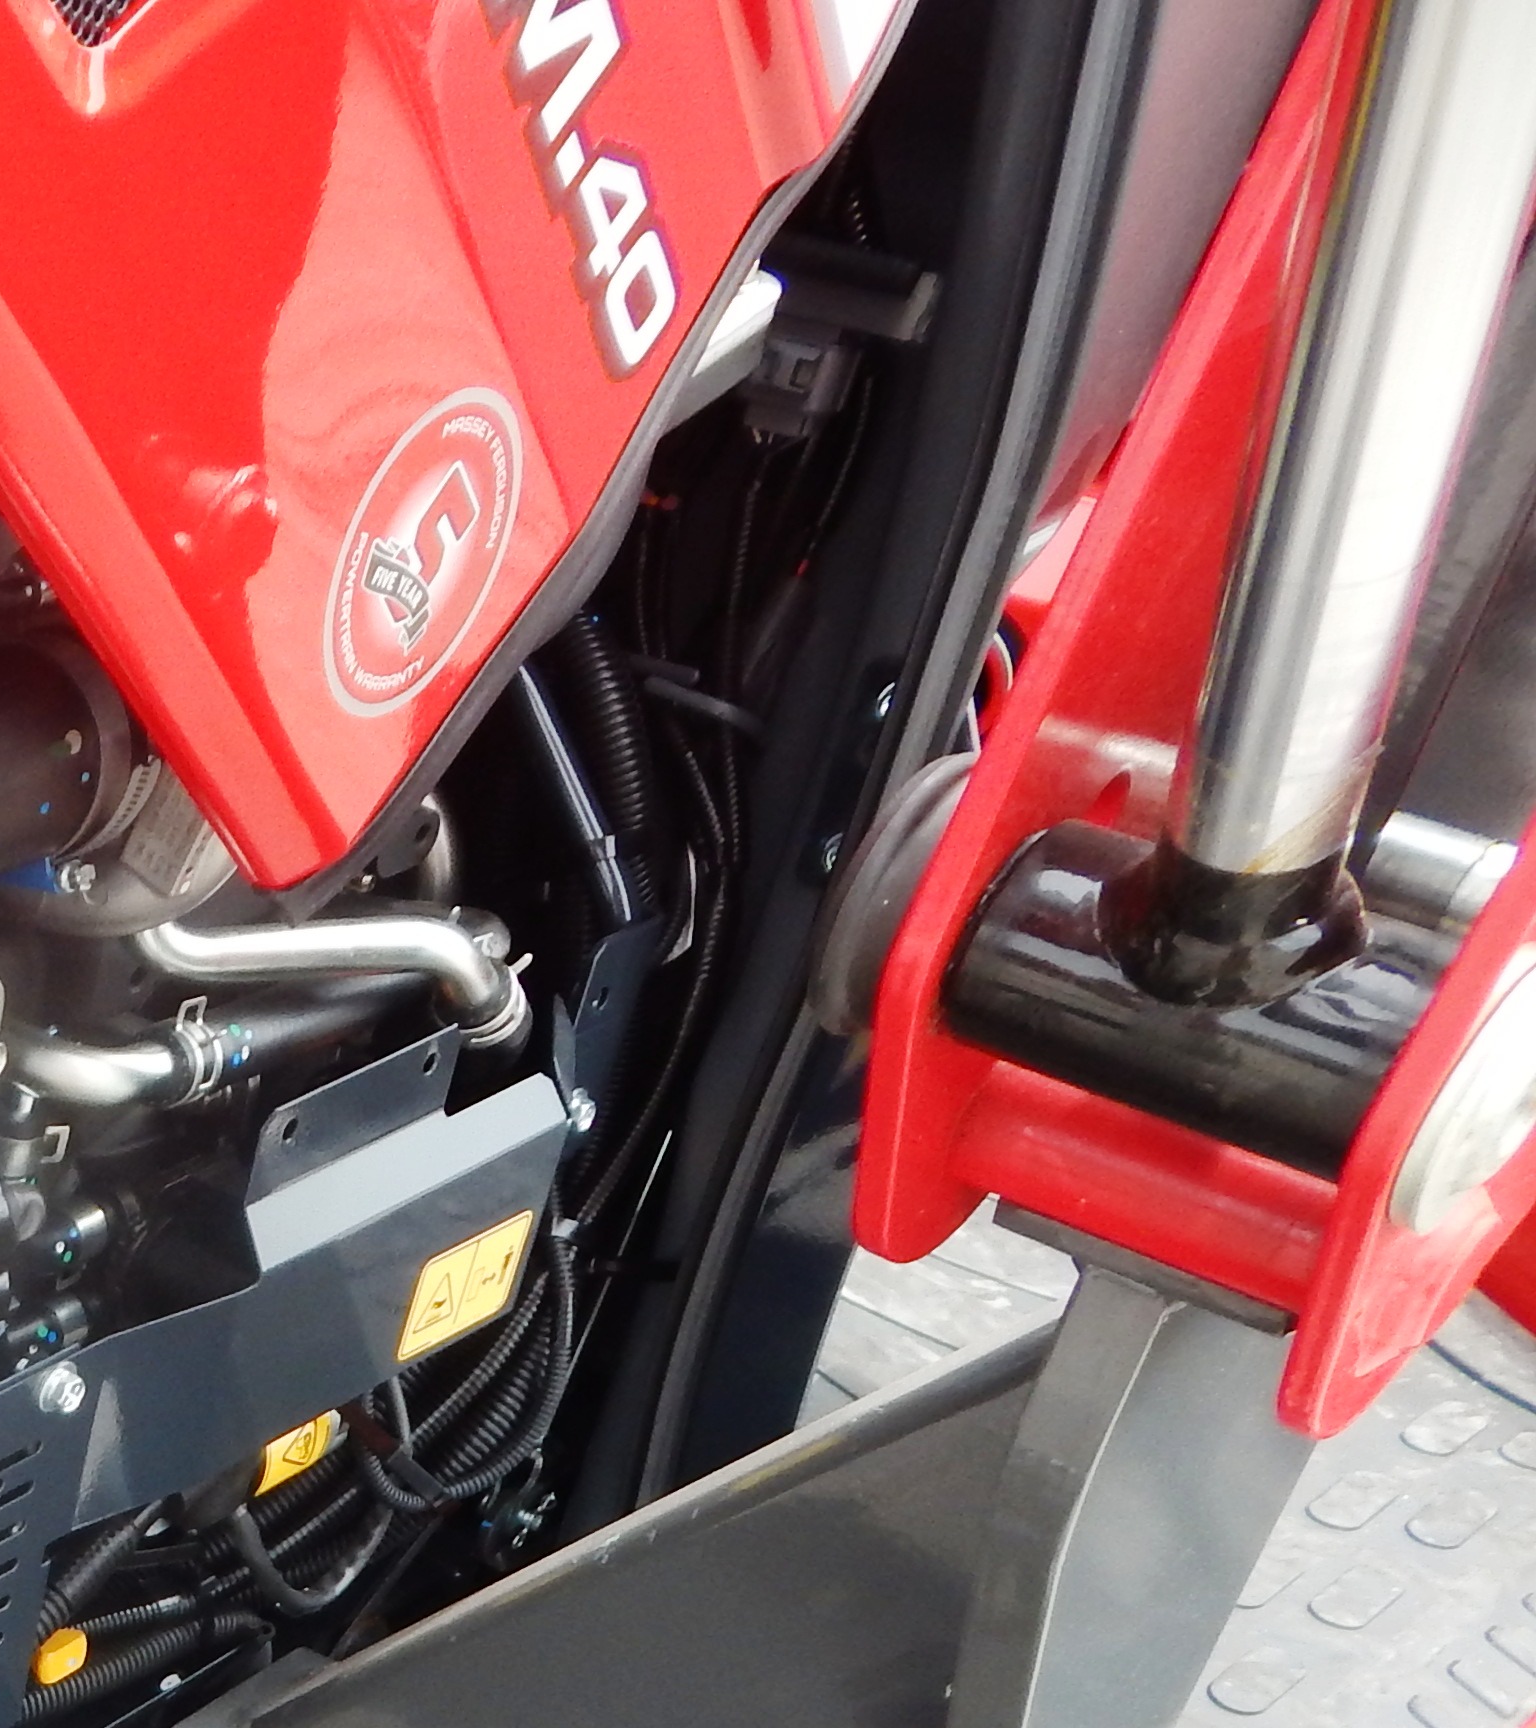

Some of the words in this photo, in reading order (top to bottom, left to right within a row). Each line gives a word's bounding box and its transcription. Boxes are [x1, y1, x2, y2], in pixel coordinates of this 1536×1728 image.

[441, 415, 496, 443] MASSEY
[339, 531, 370, 674] POWERTRAIN
[370, 565, 399, 592] FIVE
[396, 573, 424, 610] YEAR
[353, 655, 425, 691] WARRANTY
